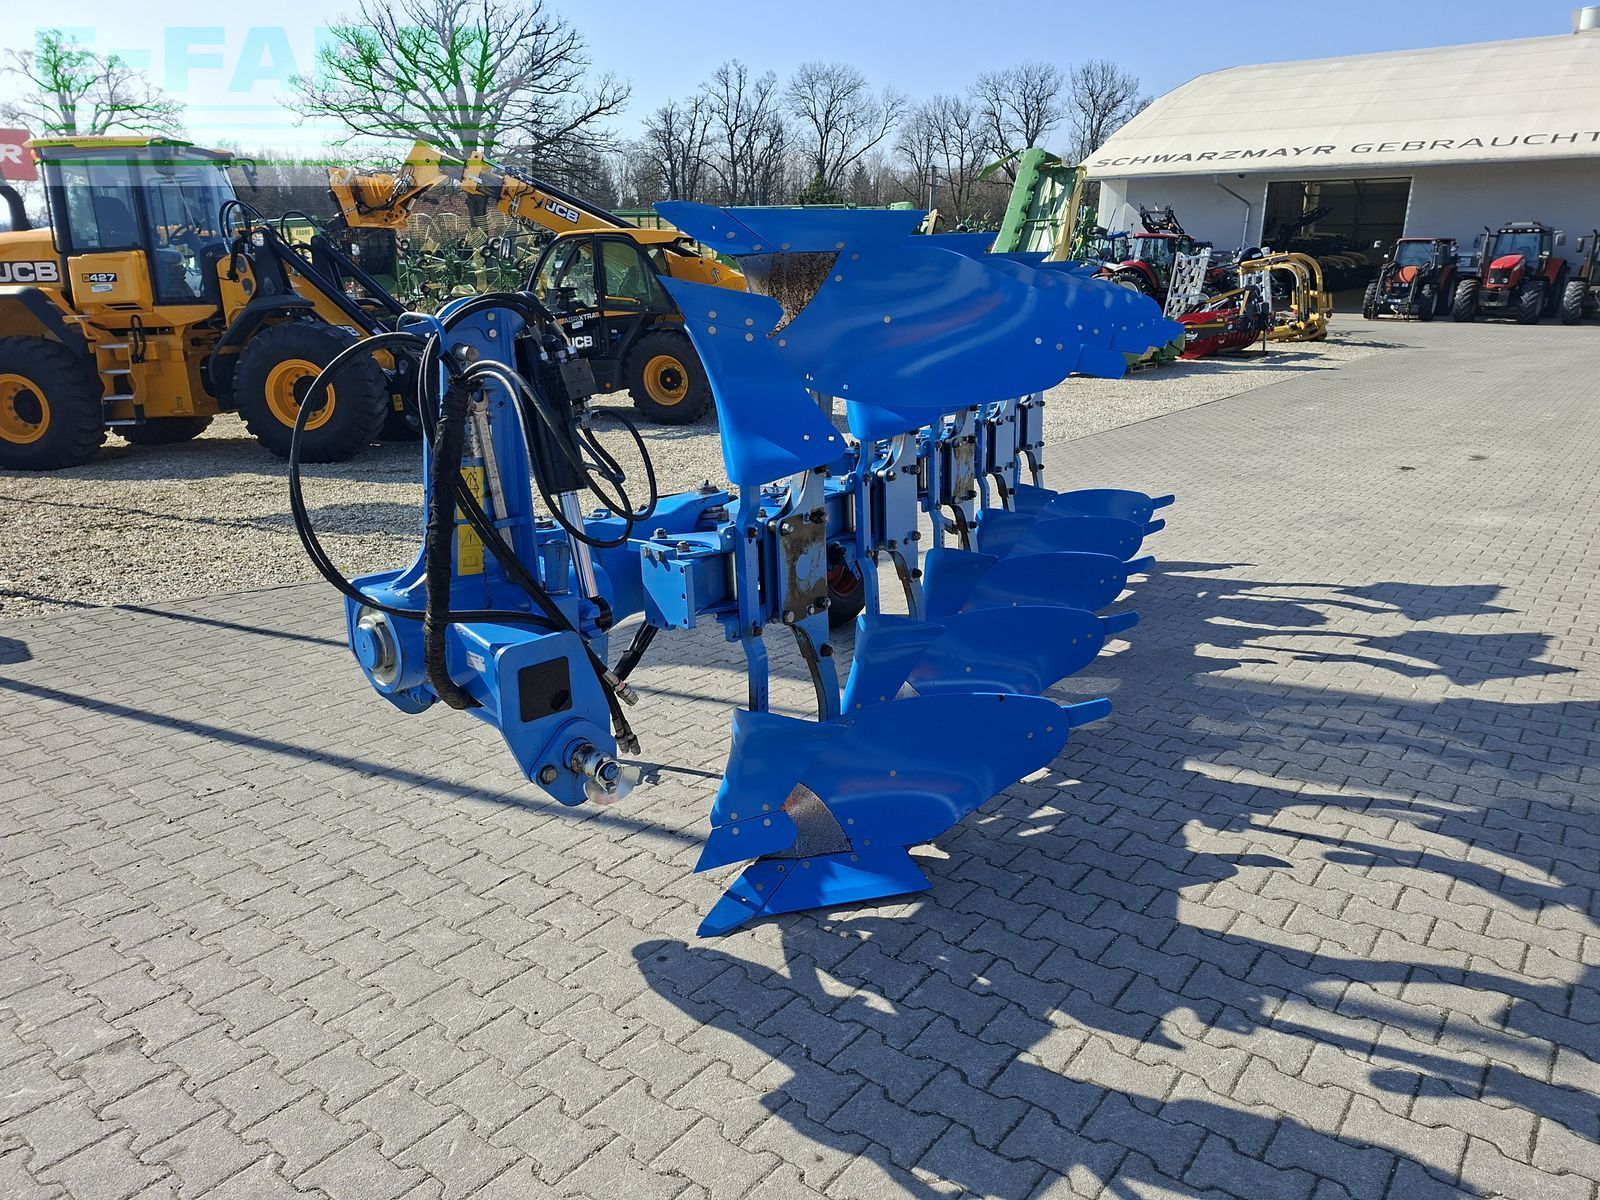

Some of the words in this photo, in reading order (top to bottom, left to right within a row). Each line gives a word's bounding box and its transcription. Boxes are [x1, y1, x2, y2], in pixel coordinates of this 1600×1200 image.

[1093, 145, 1337, 168] SCHWARZMAYR
[546, 202, 579, 223] JCB
[0, 262, 58, 282] JCB
[90, 273, 115, 282] 427
